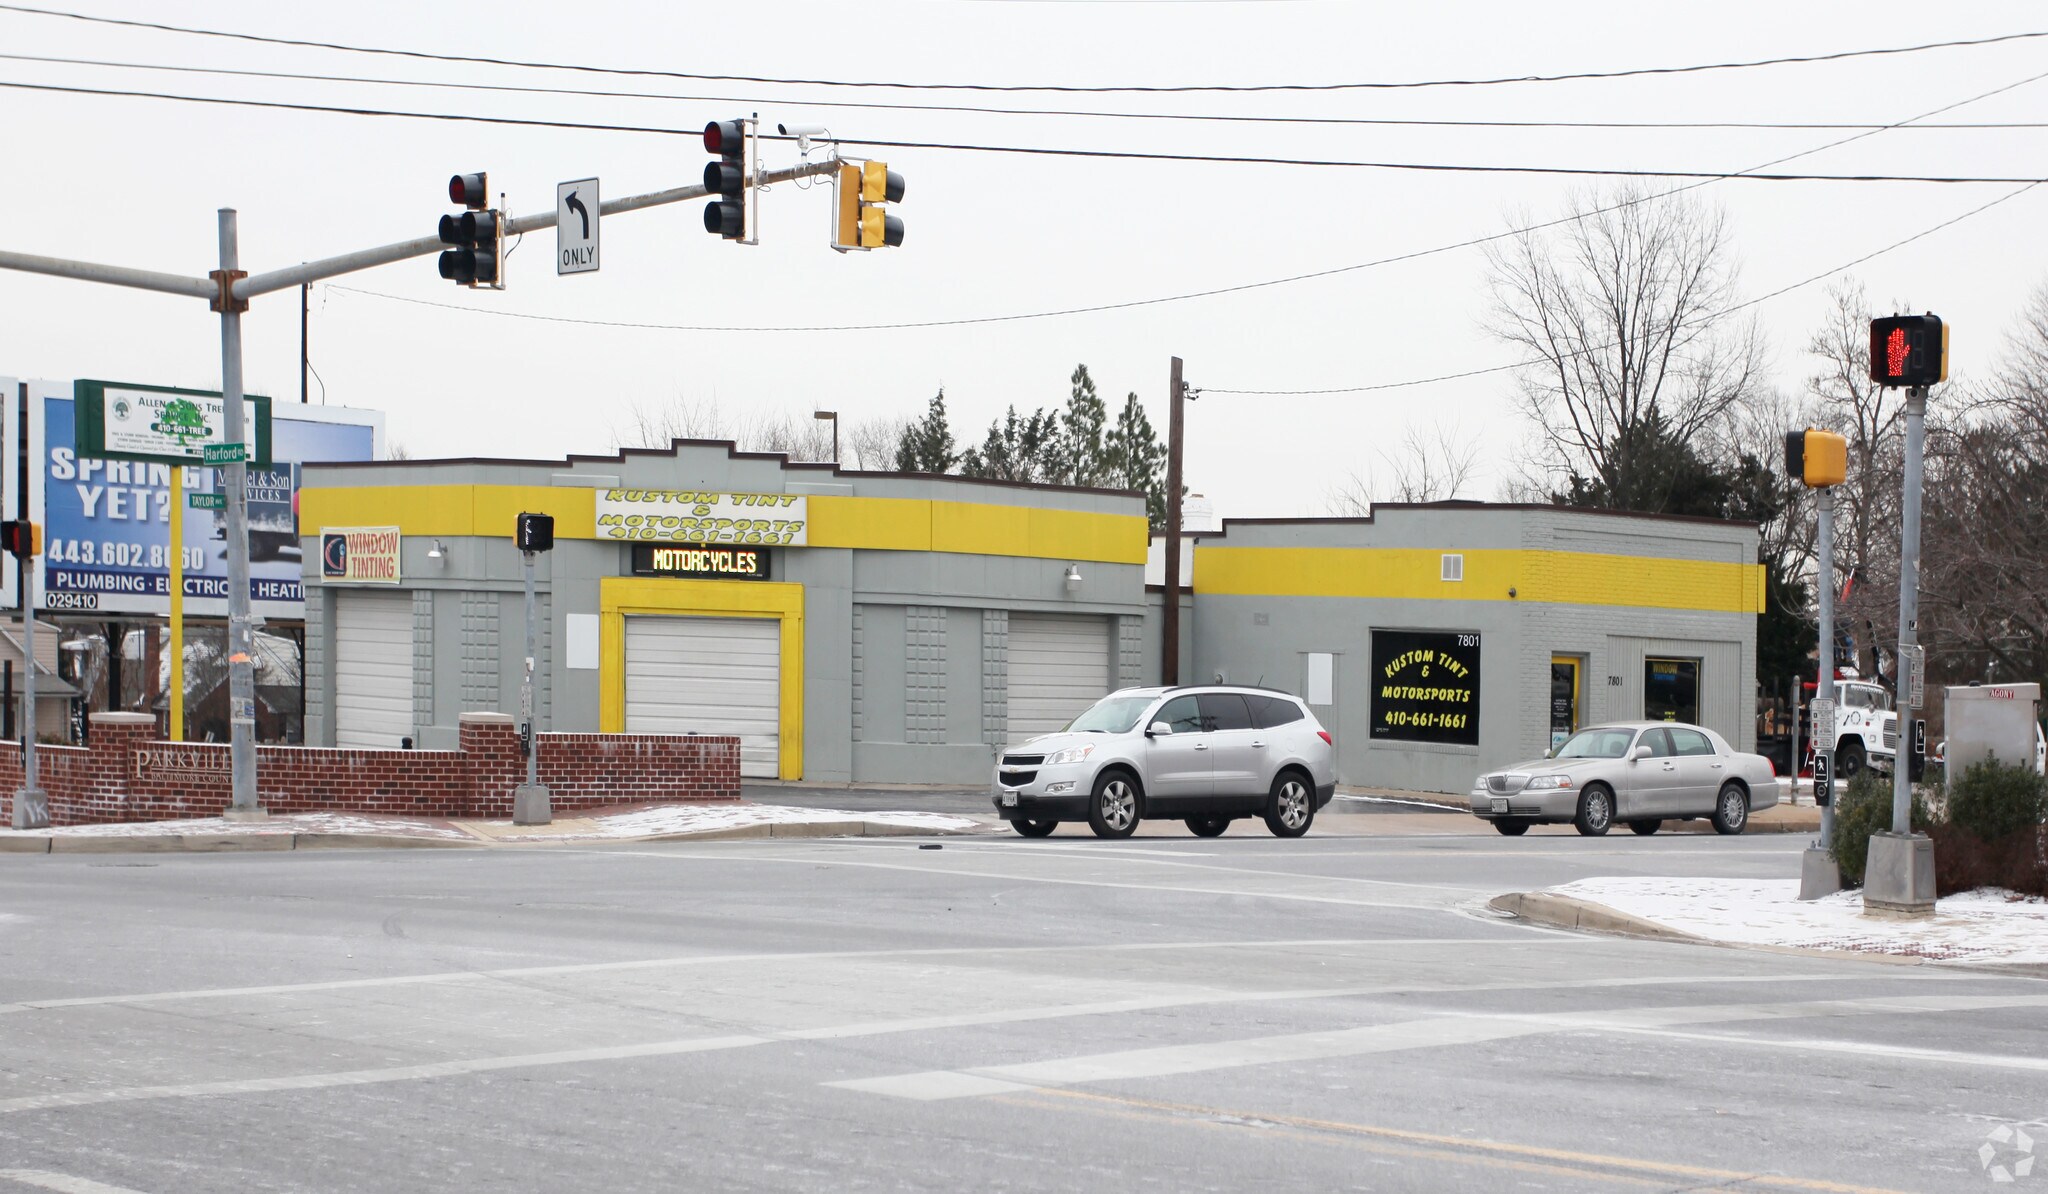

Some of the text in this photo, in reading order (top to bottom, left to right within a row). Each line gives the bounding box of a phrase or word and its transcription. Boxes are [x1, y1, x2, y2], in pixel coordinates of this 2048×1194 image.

[563, 246, 594, 266] ONLY
[138, 397, 166, 408] ALLEN
[180, 400, 202, 411] SONS
[206, 403, 224, 414] TRE
[157, 424, 206, 435] 410-661-TREE
[205, 446, 237, 460] Harford
[51, 447, 200, 489] SPRING
[258, 471, 268, 487] &
[270, 472, 290, 488] Son
[76, 484, 170, 522] YET?
[192, 496, 215, 506] TAYLOR
[247, 488, 280, 501] VICES
[606, 490, 798, 508] KUSTOM TINT
[692, 504, 711, 516] &
[598, 514, 804, 533] MOTORSPORTS
[348, 532, 398, 554] WINDOW
[608, 527, 795, 544] 410-661-1661
[352, 556, 394, 578] TINTING
[653, 548, 756, 573] MOTORCYCLES
[57, 572, 145, 592] PLUMBING
[156, 577, 229, 596] ELCTRIC
[47, 593, 96, 608] 029410
[1458, 635, 1480, 646] 7801
[1384, 650, 1468, 678] KUSTOM TINT
[1421, 665, 1430, 678] &
[1652, 662, 1678, 674] WINDOW
[1608, 676, 1623, 686] 7801
[1382, 686, 1470, 702] MOTORSPORTS
[1990, 688, 2014, 698] AGONY
[1385, 711, 1466, 728] 410-661-1661
[133, 750, 232, 778] PARKVILL
[202, 775, 232, 784] COUN
